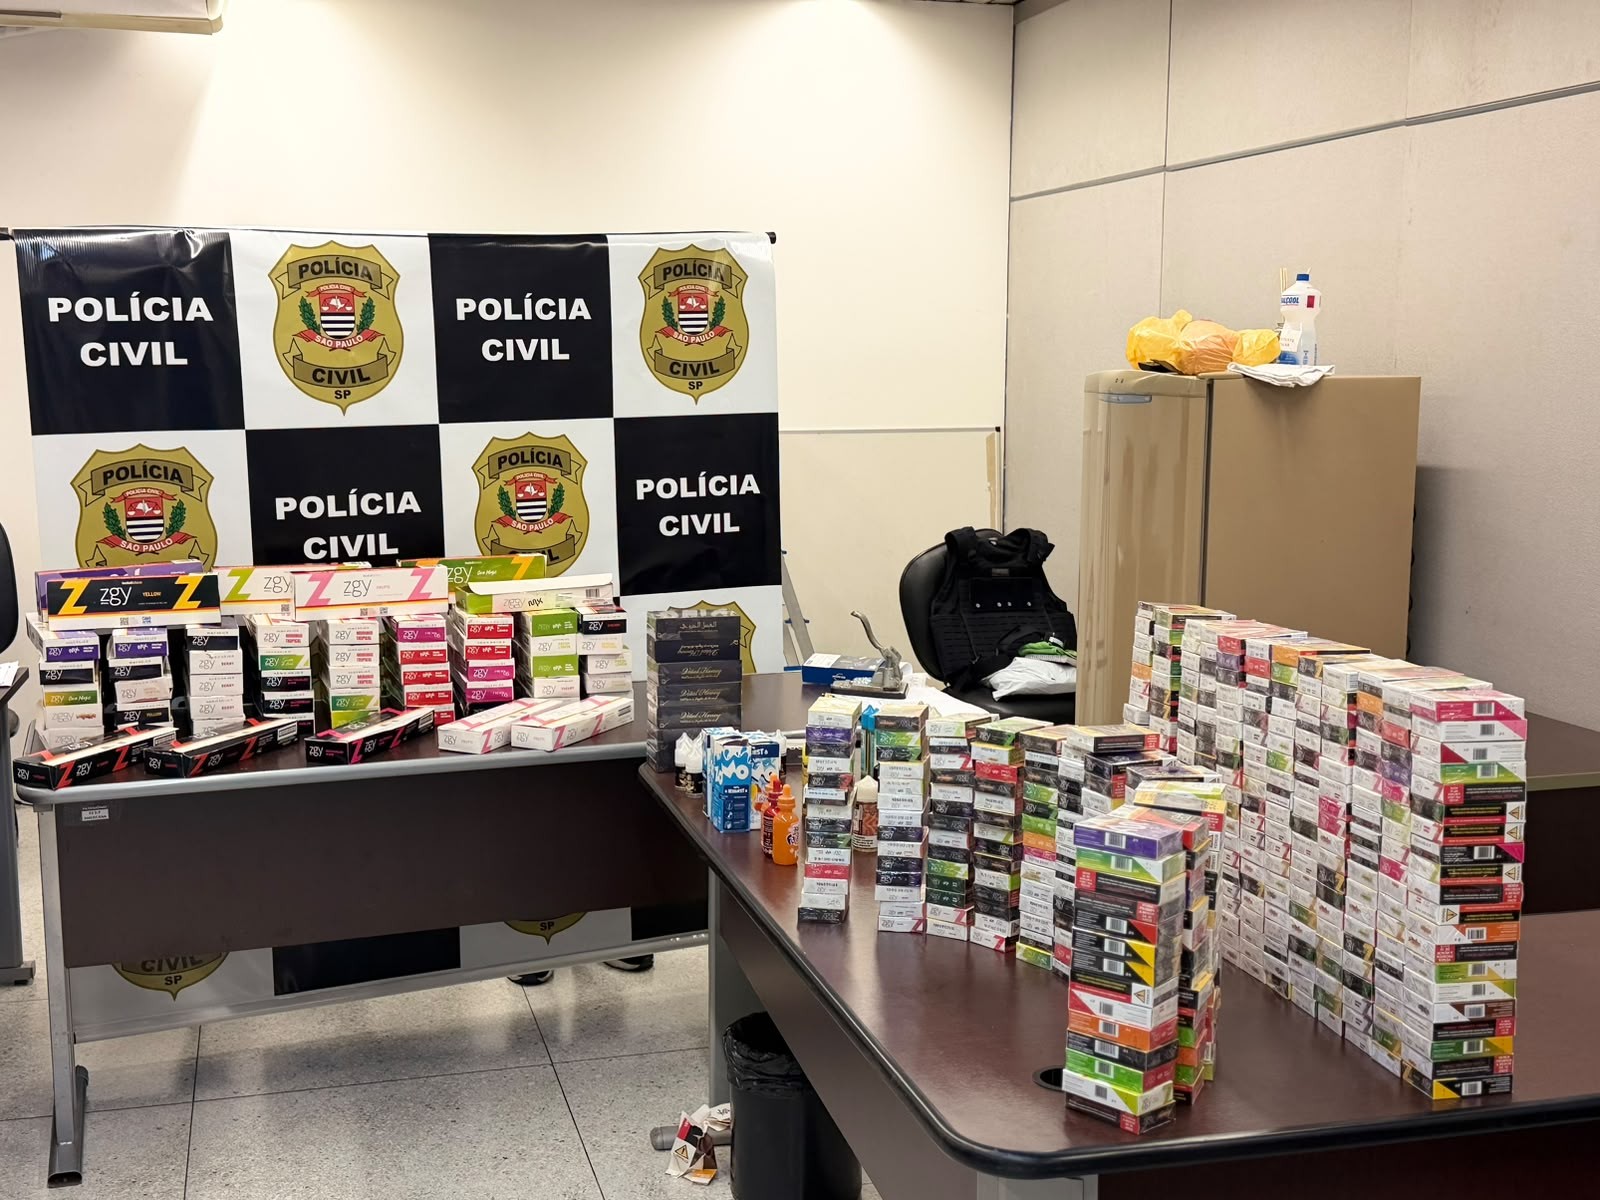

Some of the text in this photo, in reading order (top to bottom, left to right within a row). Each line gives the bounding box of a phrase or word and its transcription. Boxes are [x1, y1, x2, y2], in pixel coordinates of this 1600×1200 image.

[298, 257, 373, 281] POLÍCIA
[663, 260, 725, 281] POLÍCIA
[48, 291, 214, 322] POLÍCIA
[455, 293, 592, 321] POLÍCIA
[335, 335, 363, 348] PAULO
[690, 331, 715, 343] PAULO
[79, 341, 189, 366] CIVIL
[481, 338, 570, 362] CIVIL
[311, 368, 371, 385] CIVIL
[669, 361, 720, 377] CIVIL
[334, 390, 351, 400] SP
[688, 381, 703, 390] SP
[498, 448, 563, 470] POLÍCIA
[103, 461, 184, 486] POLÍCIA
[636, 471, 760, 500] POLÍCIA
[275, 488, 422, 521] POLÍCIA
[529, 519, 554, 531] PAULO
[658, 512, 740, 537] CIVIL
[142, 537, 174, 552] PAULO
[303, 533, 399, 560] CIVIL
[540, 921, 554, 931] SP
[141, 955, 203, 972] CIVIL
[164, 975, 182, 985] SP
